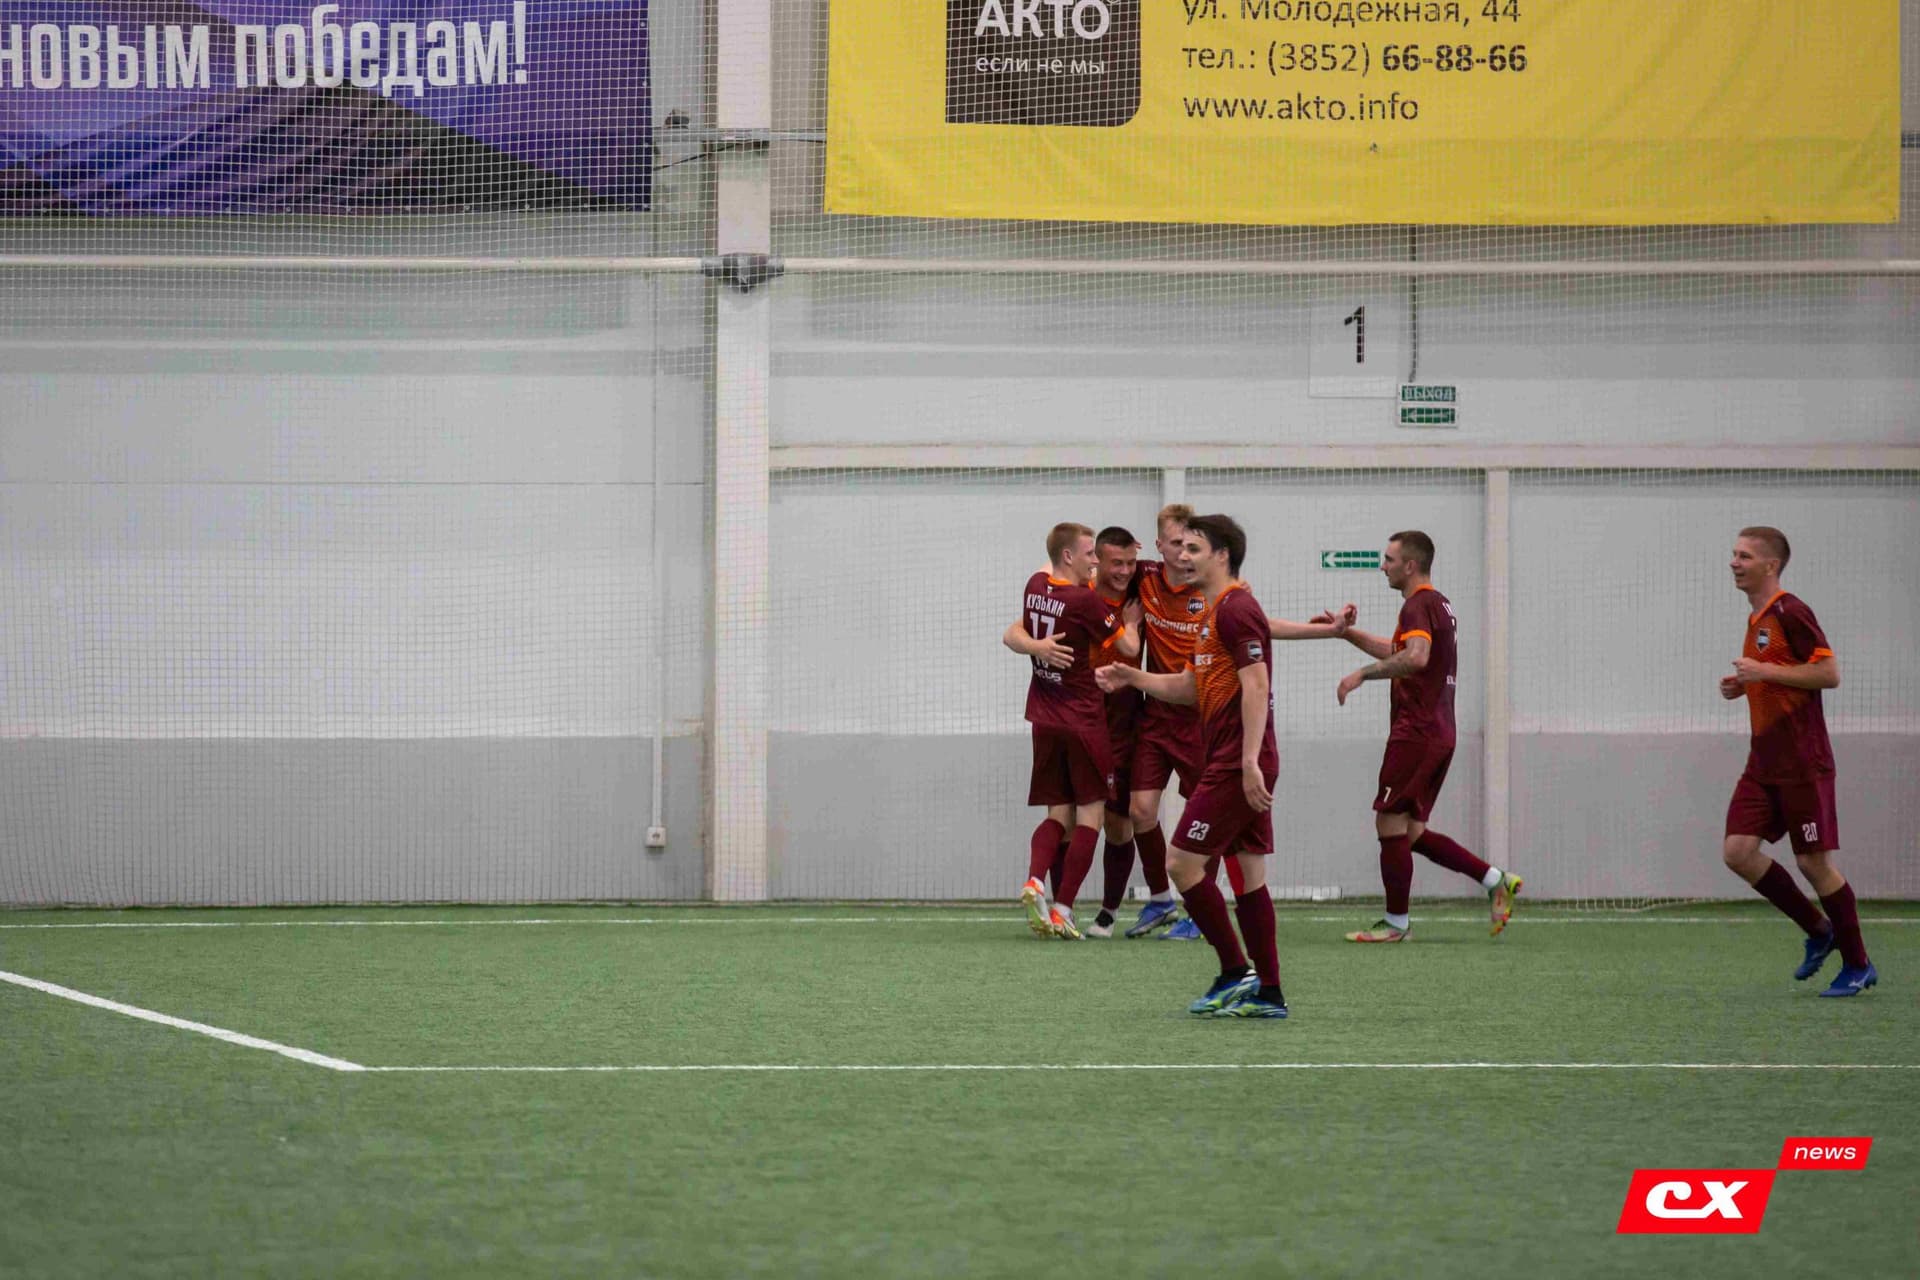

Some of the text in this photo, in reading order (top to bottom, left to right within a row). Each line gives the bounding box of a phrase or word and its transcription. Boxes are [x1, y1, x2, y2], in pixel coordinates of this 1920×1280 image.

[974, 0, 1110, 40] АКТО
[1183, 0, 1521, 28] ул. Молодежная, 44
[0, 0, 527, 97] новым победам!
[1182, 40, 1528, 76] тел.: (3852) 66-88-66
[975, 56, 1105, 75] если не мы
[1184, 92, 1419, 121] www.akto.info
[1344, 304, 1365, 363] 1
[1026, 593, 1066, 617] КУЗЬКИН
[1029, 611, 1056, 641] 17
[1187, 820, 1210, 841] 23
[1802, 822, 1818, 842] 20
